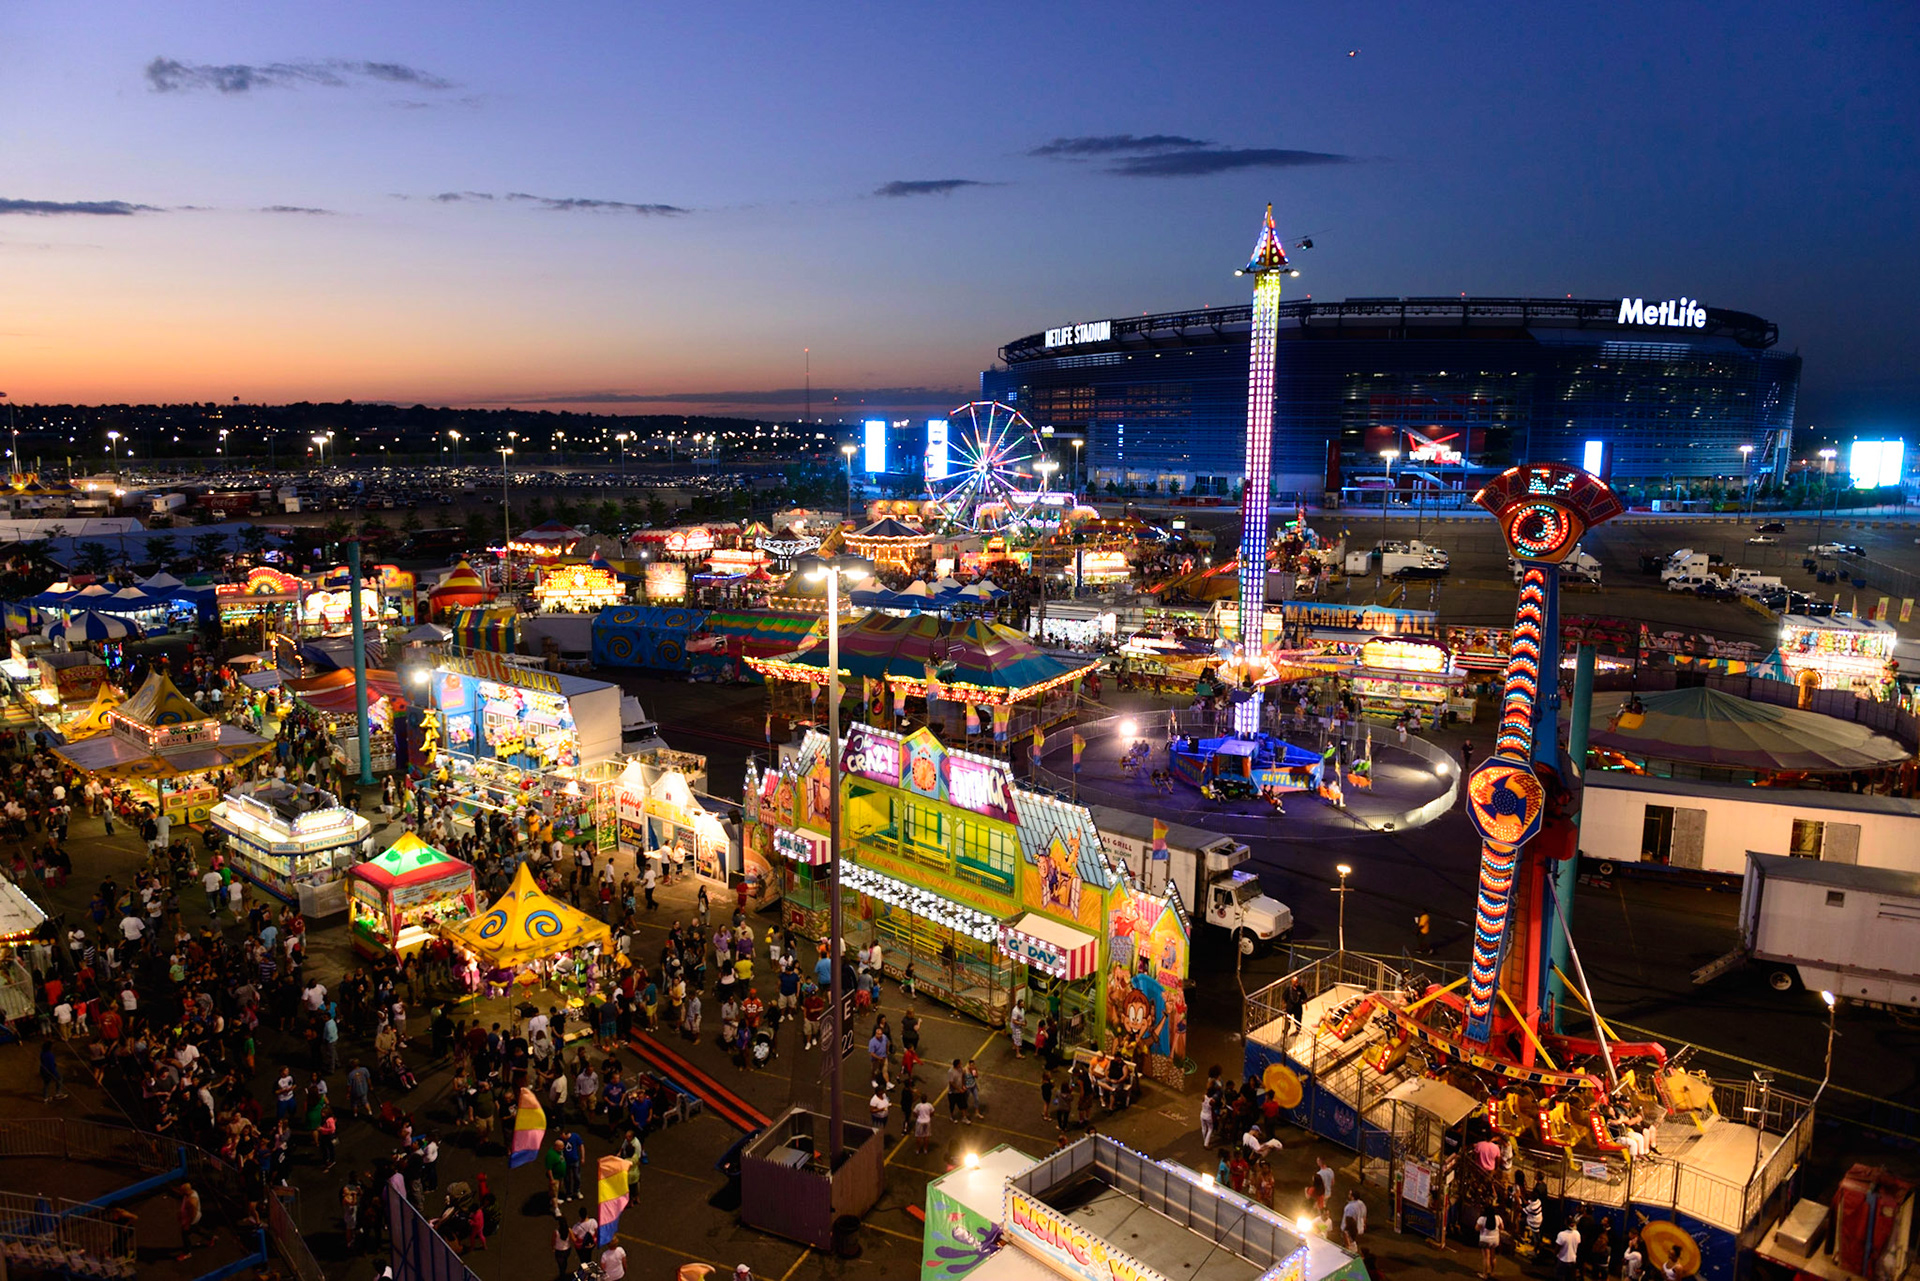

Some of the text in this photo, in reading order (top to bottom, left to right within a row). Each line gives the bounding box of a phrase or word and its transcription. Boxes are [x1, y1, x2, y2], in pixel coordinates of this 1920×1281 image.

[1618, 297, 1706, 328] MetLife
[1045, 321, 1111, 348] METLIFE STADIUM
[266, 612, 277, 640] ATM
[1285, 605, 1358, 630] MACHINE
[1360, 611, 1396, 632] GUN
[473, 650, 511, 682] BIG
[511, 668, 562, 694] PRIZES
[847, 745, 894, 775] CRAZY
[950, 765, 1009, 814] OUTBACK
[305, 834, 356, 850] POPCORN
[620, 824, 634, 839] 29
[780, 836, 807, 857] BAIL OUT
[1112, 839, 1132, 852] GRILL
[1028, 946, 1056, 965] DAY
[746, 1003, 758, 1014] 52
[844, 999, 852, 1021] E
[841, 1029, 854, 1054] 22
[1012, 1195, 1090, 1266] RISING
